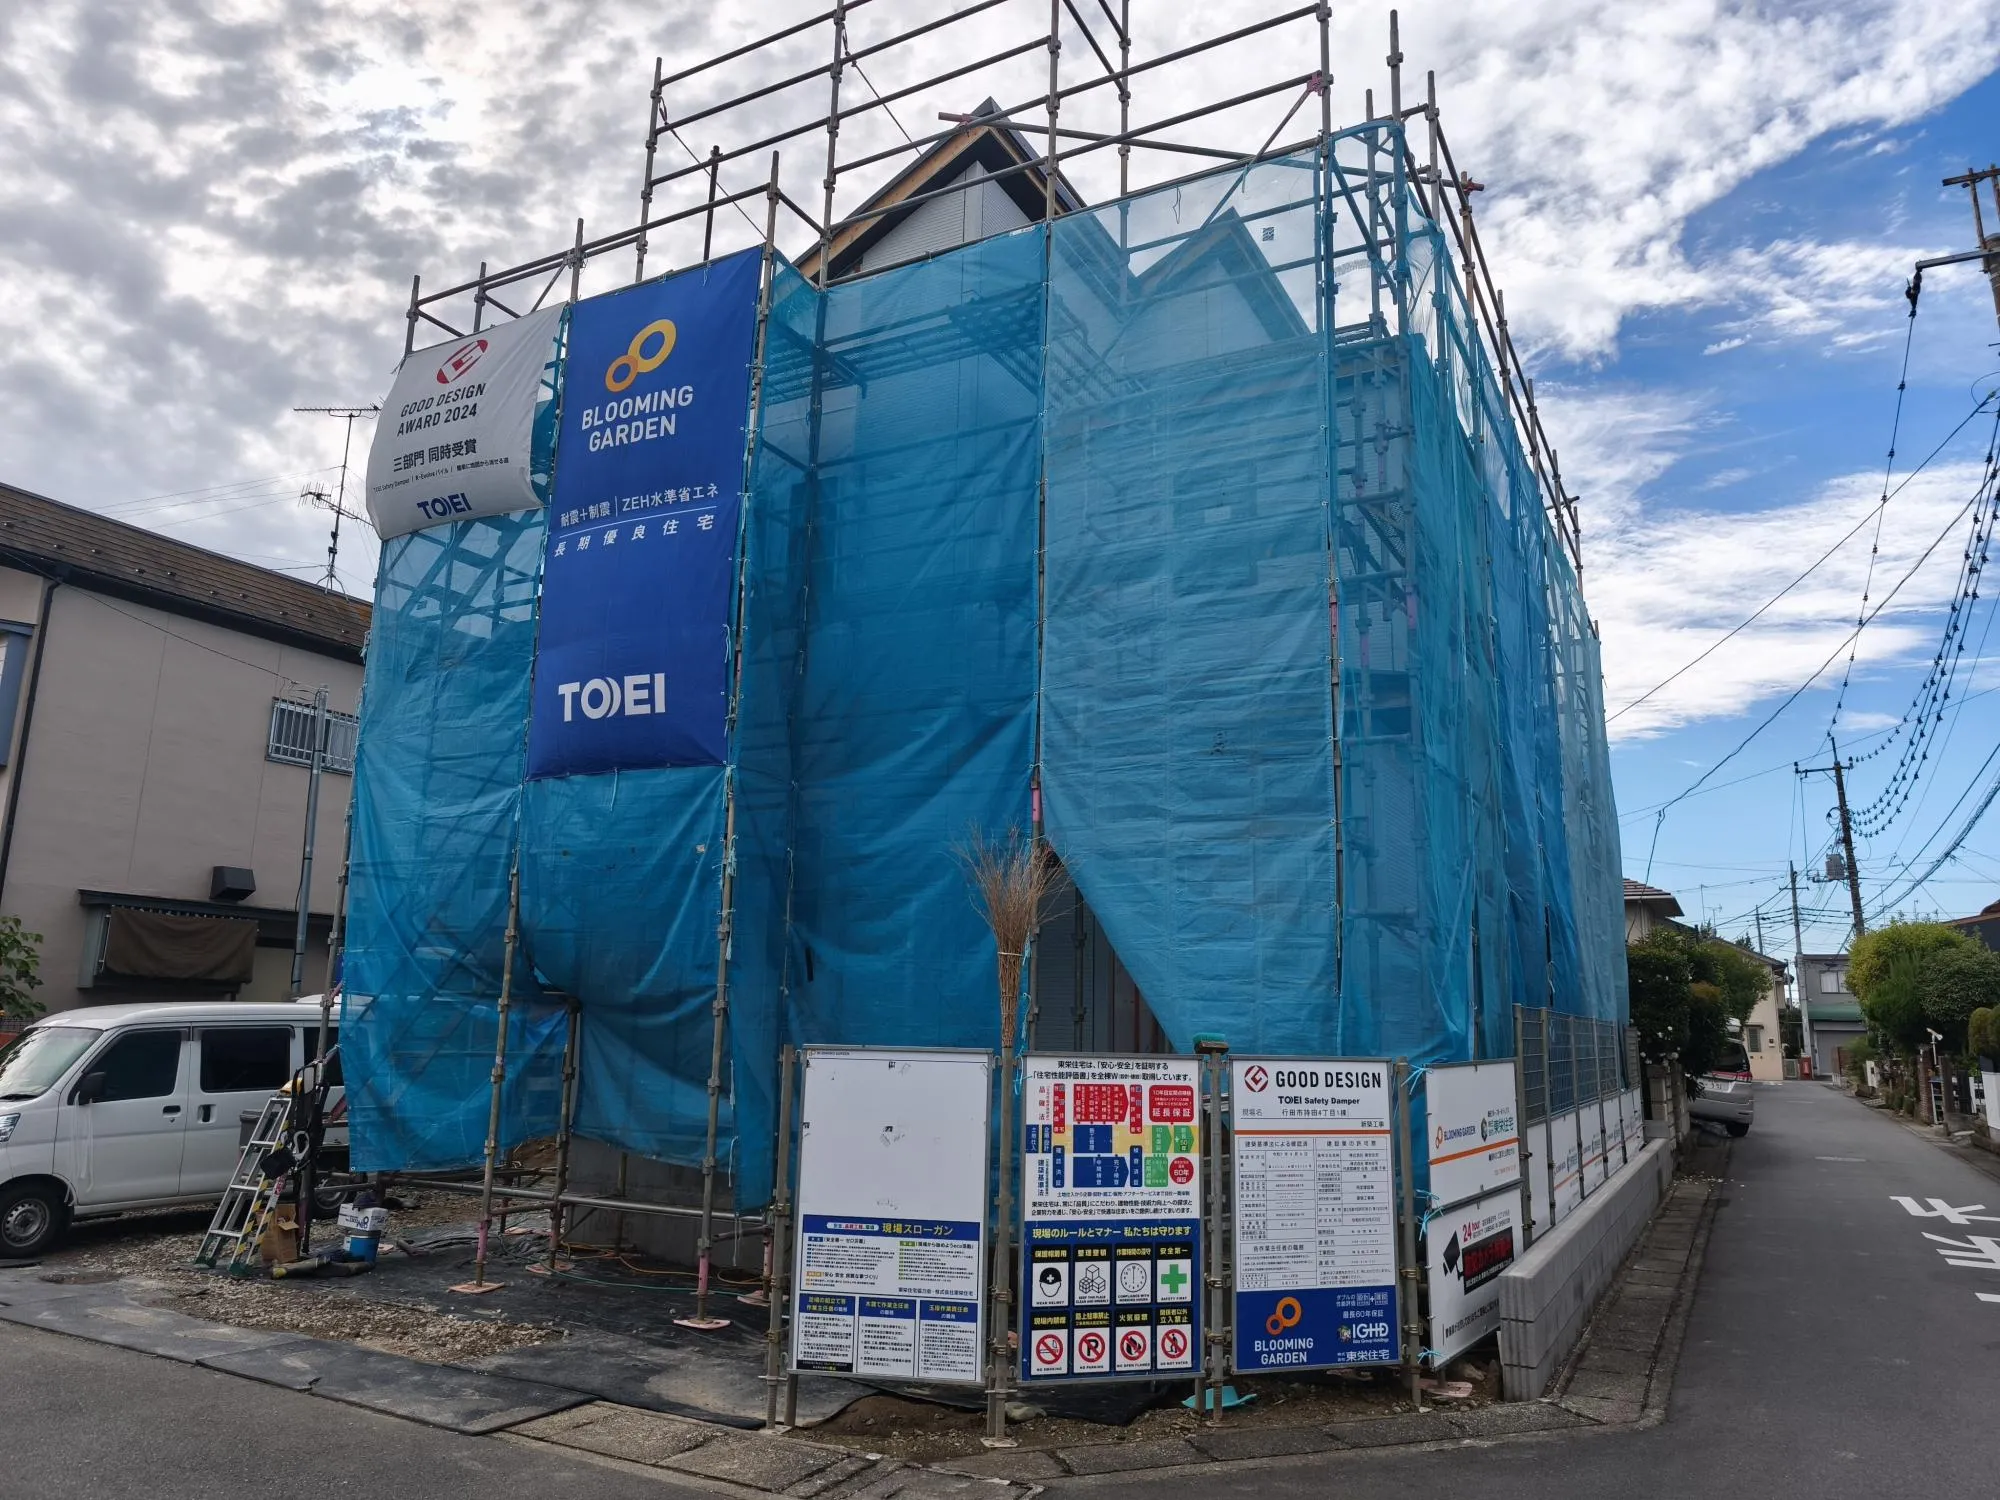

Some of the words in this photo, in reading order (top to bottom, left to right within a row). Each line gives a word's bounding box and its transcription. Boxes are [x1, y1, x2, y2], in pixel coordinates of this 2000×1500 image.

[401, 397, 434, 418] GOOD
[436, 383, 486, 406] DESIGN
[581, 385, 694, 430] BLOOMING
[397, 412, 441, 437] AWARD
[444, 403, 477, 424] 2024
[589, 414, 676, 452] GARDEN
[393, 449, 425, 472] 三部門
[429, 438, 477, 464] 同時受賞
[622, 483, 719, 512] ZEH水準省エネ
[1275, 1071, 1319, 1088] GOOD
[1324, 1071, 1381, 1088] DESIGN
[1304, 1097, 1329, 1105] Safety
[1331, 1097, 1360, 1106] Damper
[1493, 1116, 1514, 1134] 東栄住宅
[882, 1222, 953, 1235] 現場スローガン
[1032, 1227, 1121, 1238] 現場のルールとマナー
[1123, 1226, 1191, 1237] 私たちは守ります
[1463, 1222, 1472, 1242] 24
[1160, 1247, 1188, 1255] 安全第一
[1254, 1337, 1314, 1352] BLOOMING
[1261, 1351, 1307, 1365] GARDEN
[1345, 1349, 1390, 1361] 東栄住宅
